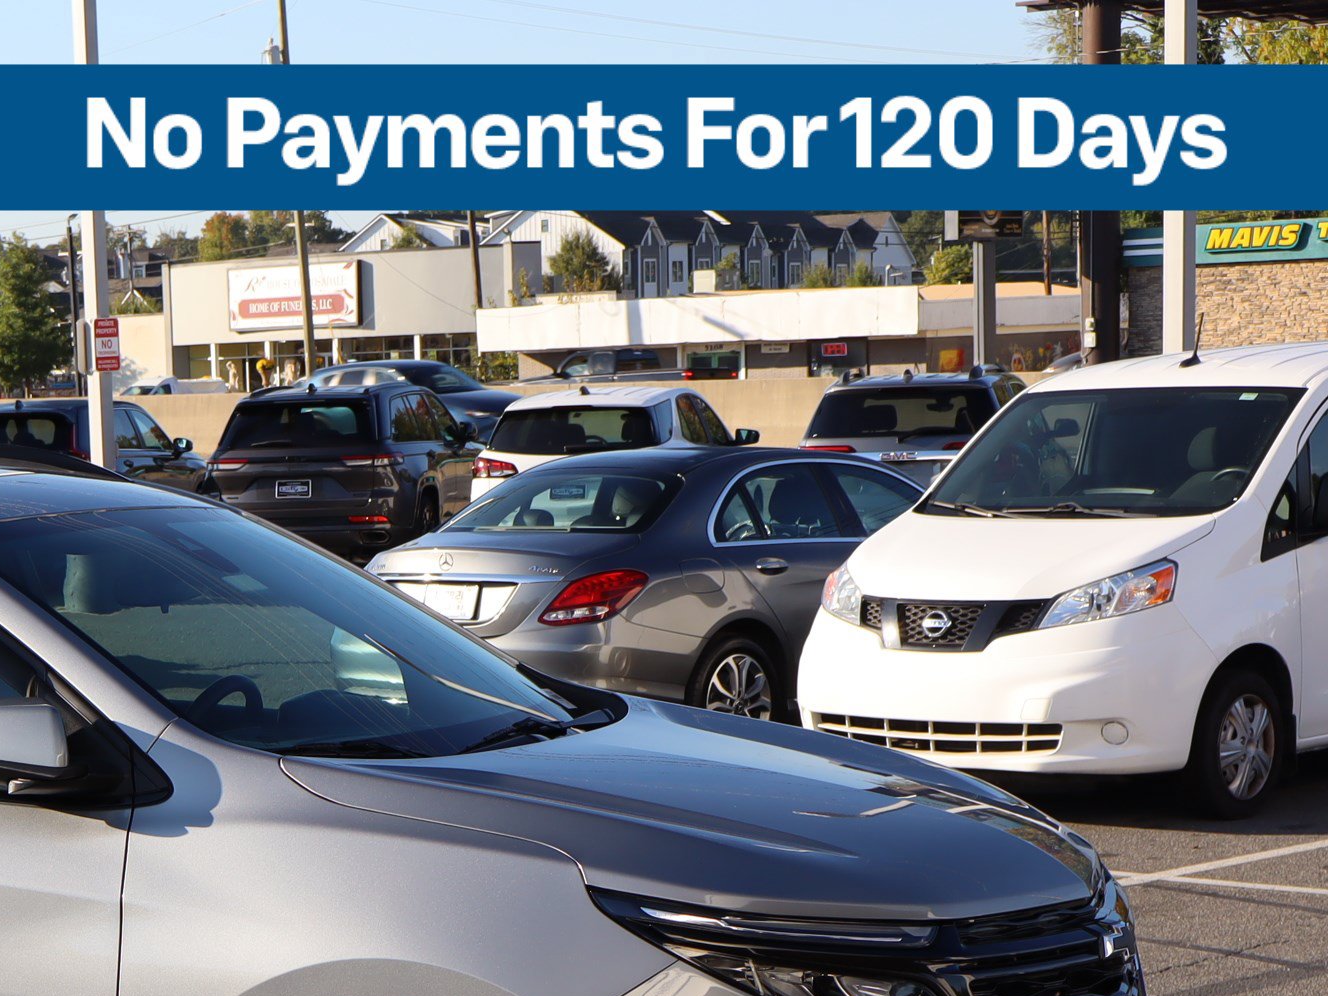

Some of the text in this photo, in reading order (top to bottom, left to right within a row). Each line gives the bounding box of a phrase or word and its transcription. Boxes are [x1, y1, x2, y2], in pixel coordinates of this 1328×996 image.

[1205, 223, 1302, 250] MAVIS
[249, 302, 270, 313] HOME
[270, 301, 281, 312] OF
[319, 298, 333, 310] LLC
[101, 339, 113, 349] NO
[879, 451, 918, 461] GMC
